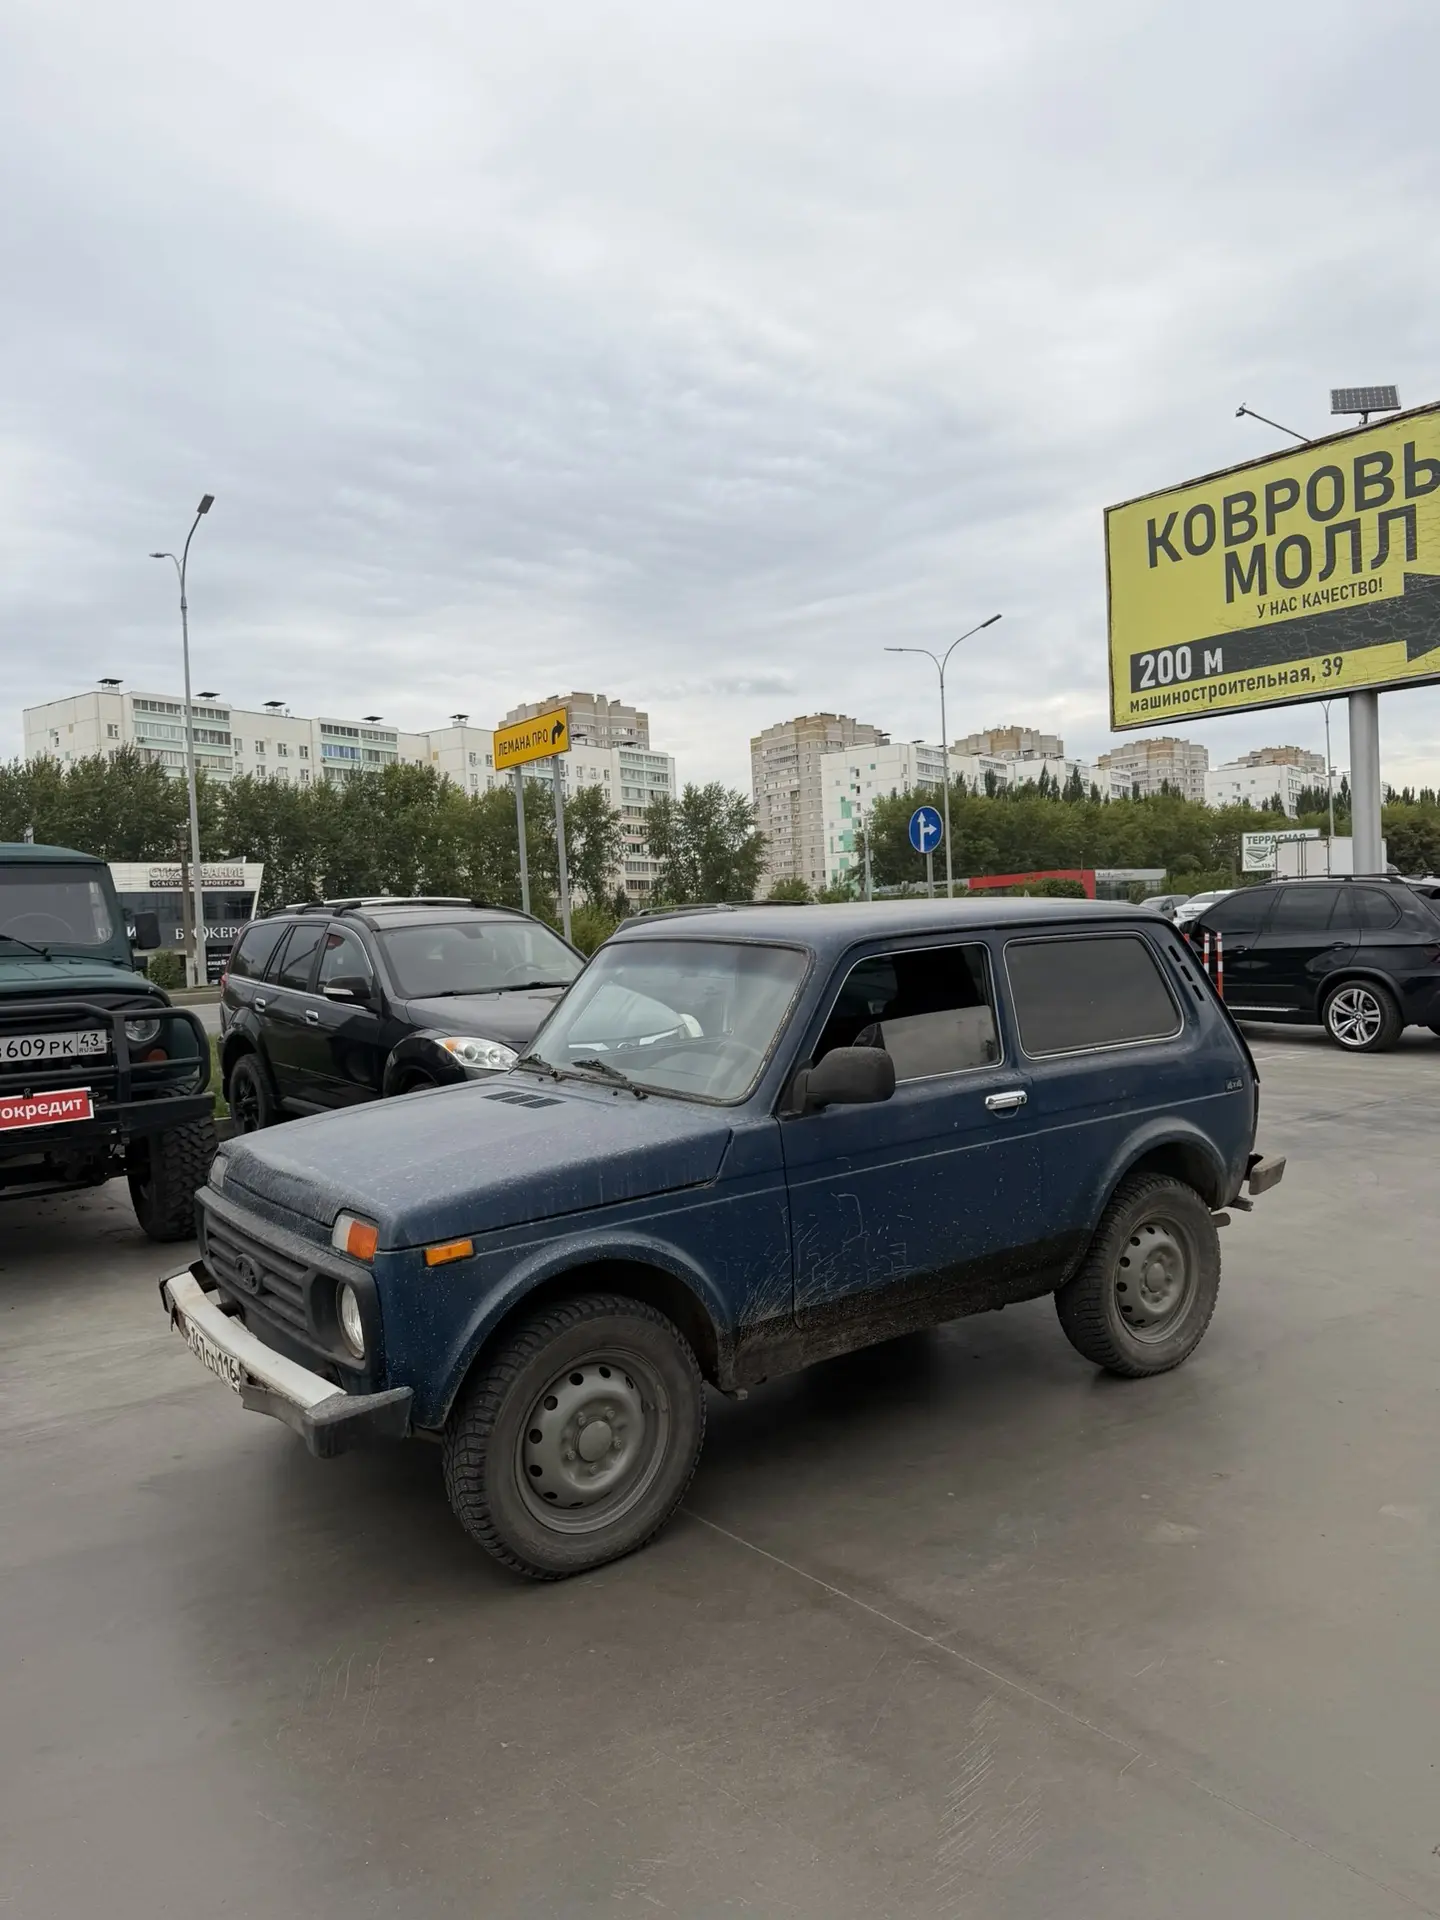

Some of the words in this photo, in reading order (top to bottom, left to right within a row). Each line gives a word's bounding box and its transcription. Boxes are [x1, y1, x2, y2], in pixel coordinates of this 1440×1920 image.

[1225, 504, 1417, 603] МОЛЛ
[1257, 603, 1265, 618] У
[1270, 596, 1297, 616] НАС
[1302, 577, 1383, 609] КАЧЕСТВО!
[1130, 667, 1316, 713] машиностроительная,
[1322, 656, 1343, 677] 39
[1139, 646, 1192, 688] 200
[498, 735, 531, 756] ЛЕМАНА
[532, 728, 548, 746] ПРО
[0, 1038, 73, 1058] 609РК
[80, 1033, 99, 1047] 43
[0, 1098, 83, 1120] окредит
